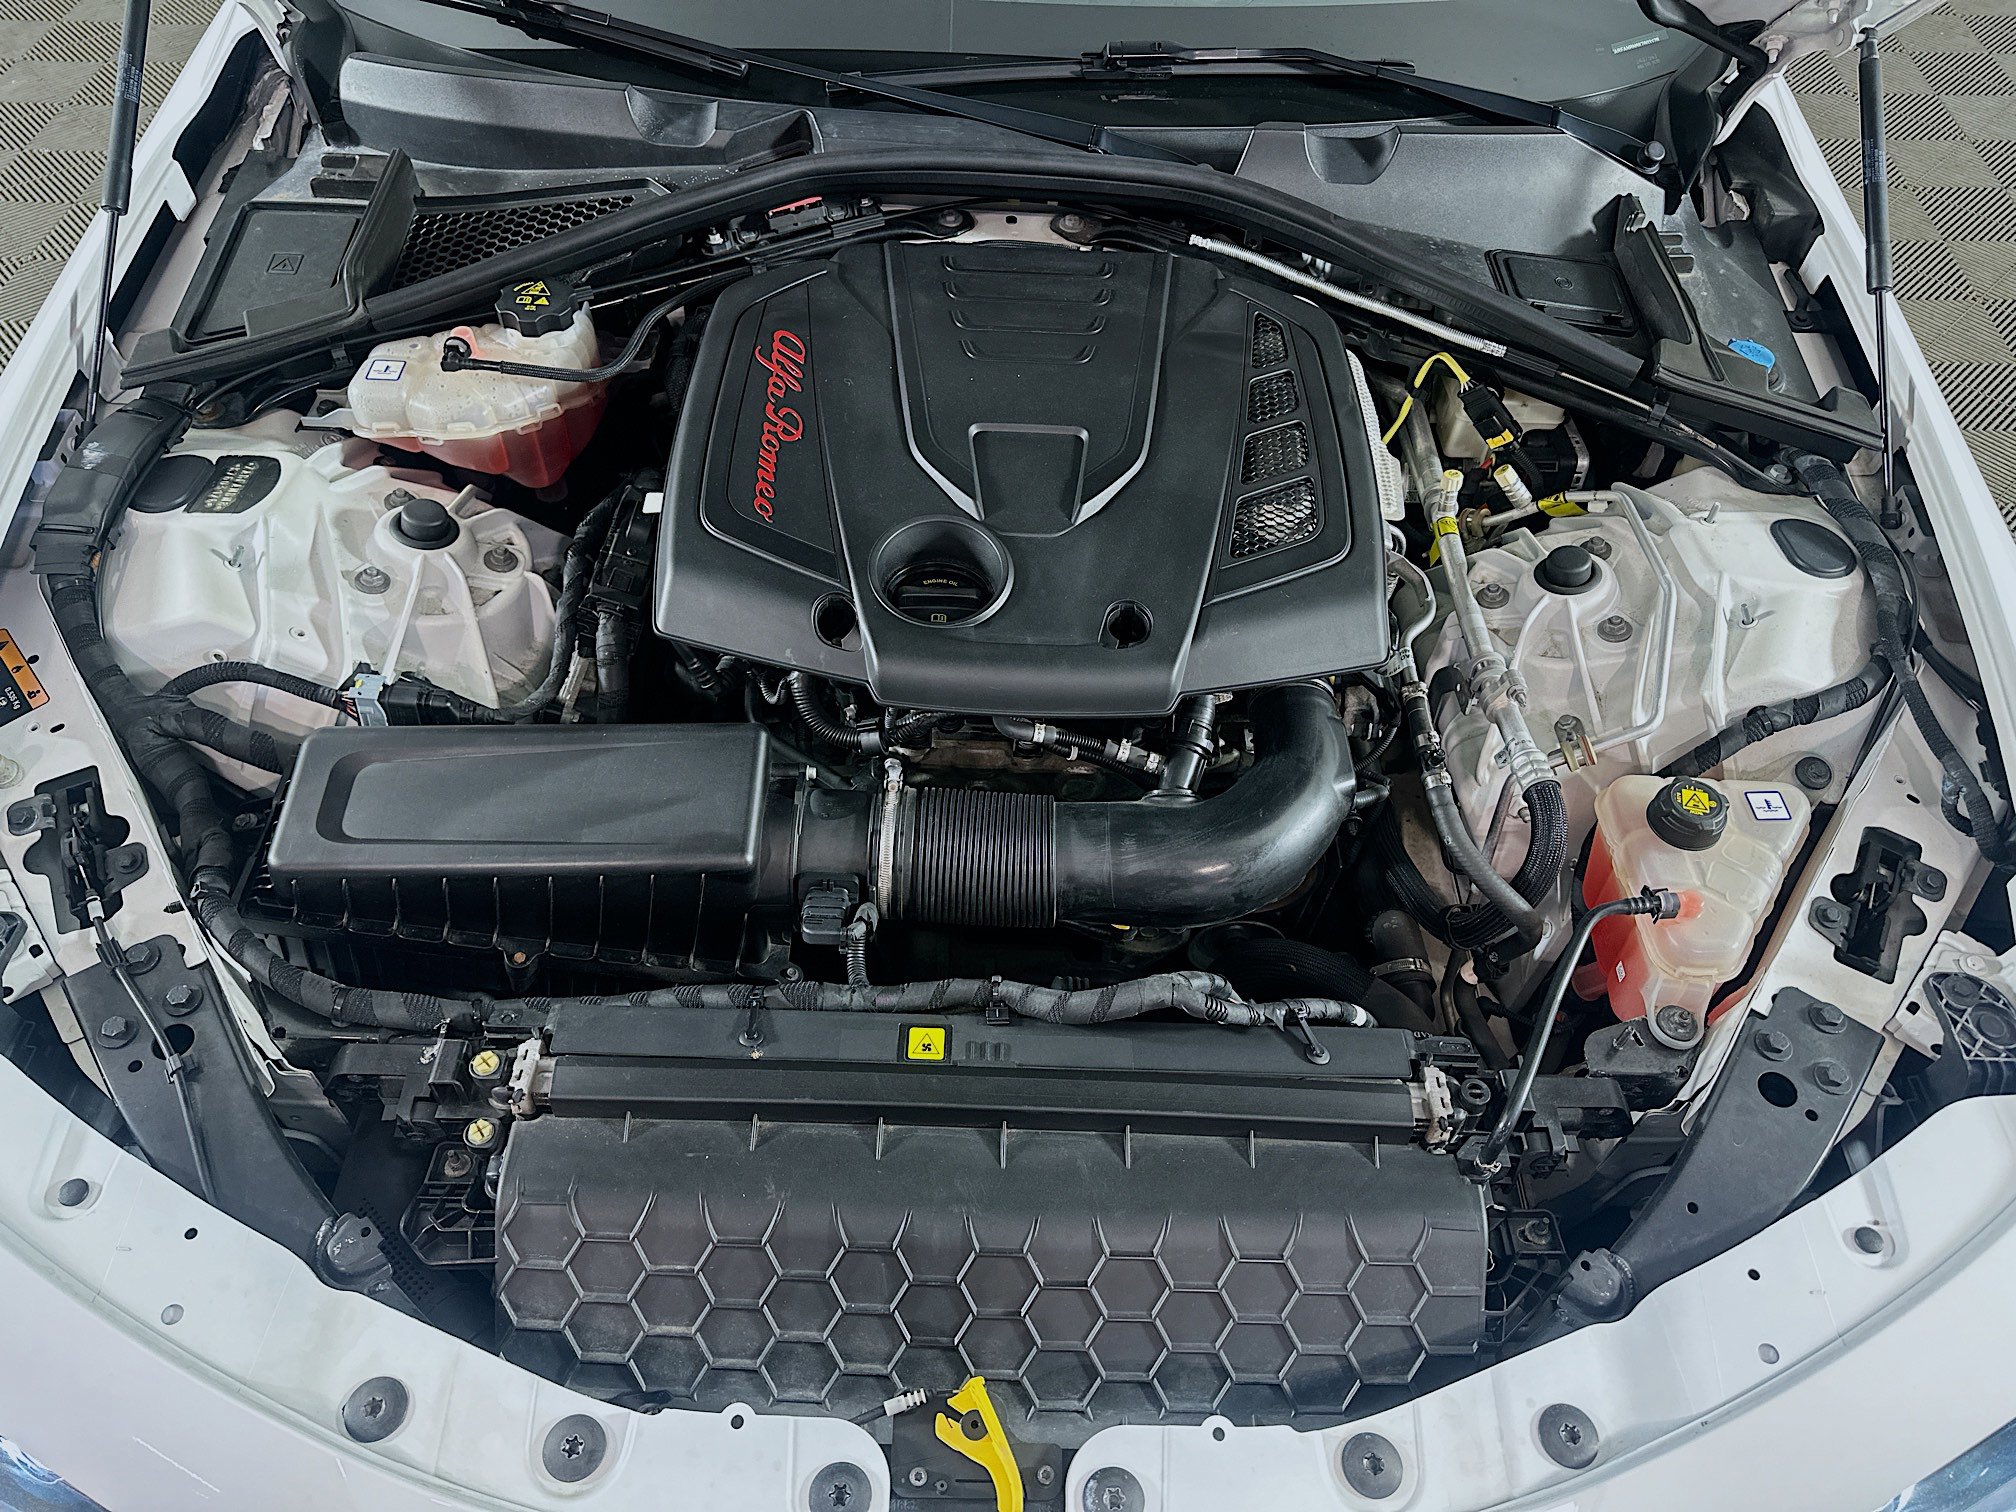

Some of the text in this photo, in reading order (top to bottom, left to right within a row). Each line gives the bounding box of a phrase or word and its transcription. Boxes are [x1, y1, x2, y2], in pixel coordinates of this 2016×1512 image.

[753, 329, 806, 523] Alfa Romeo
[4, 686, 21, 710] 0.535 Kg
